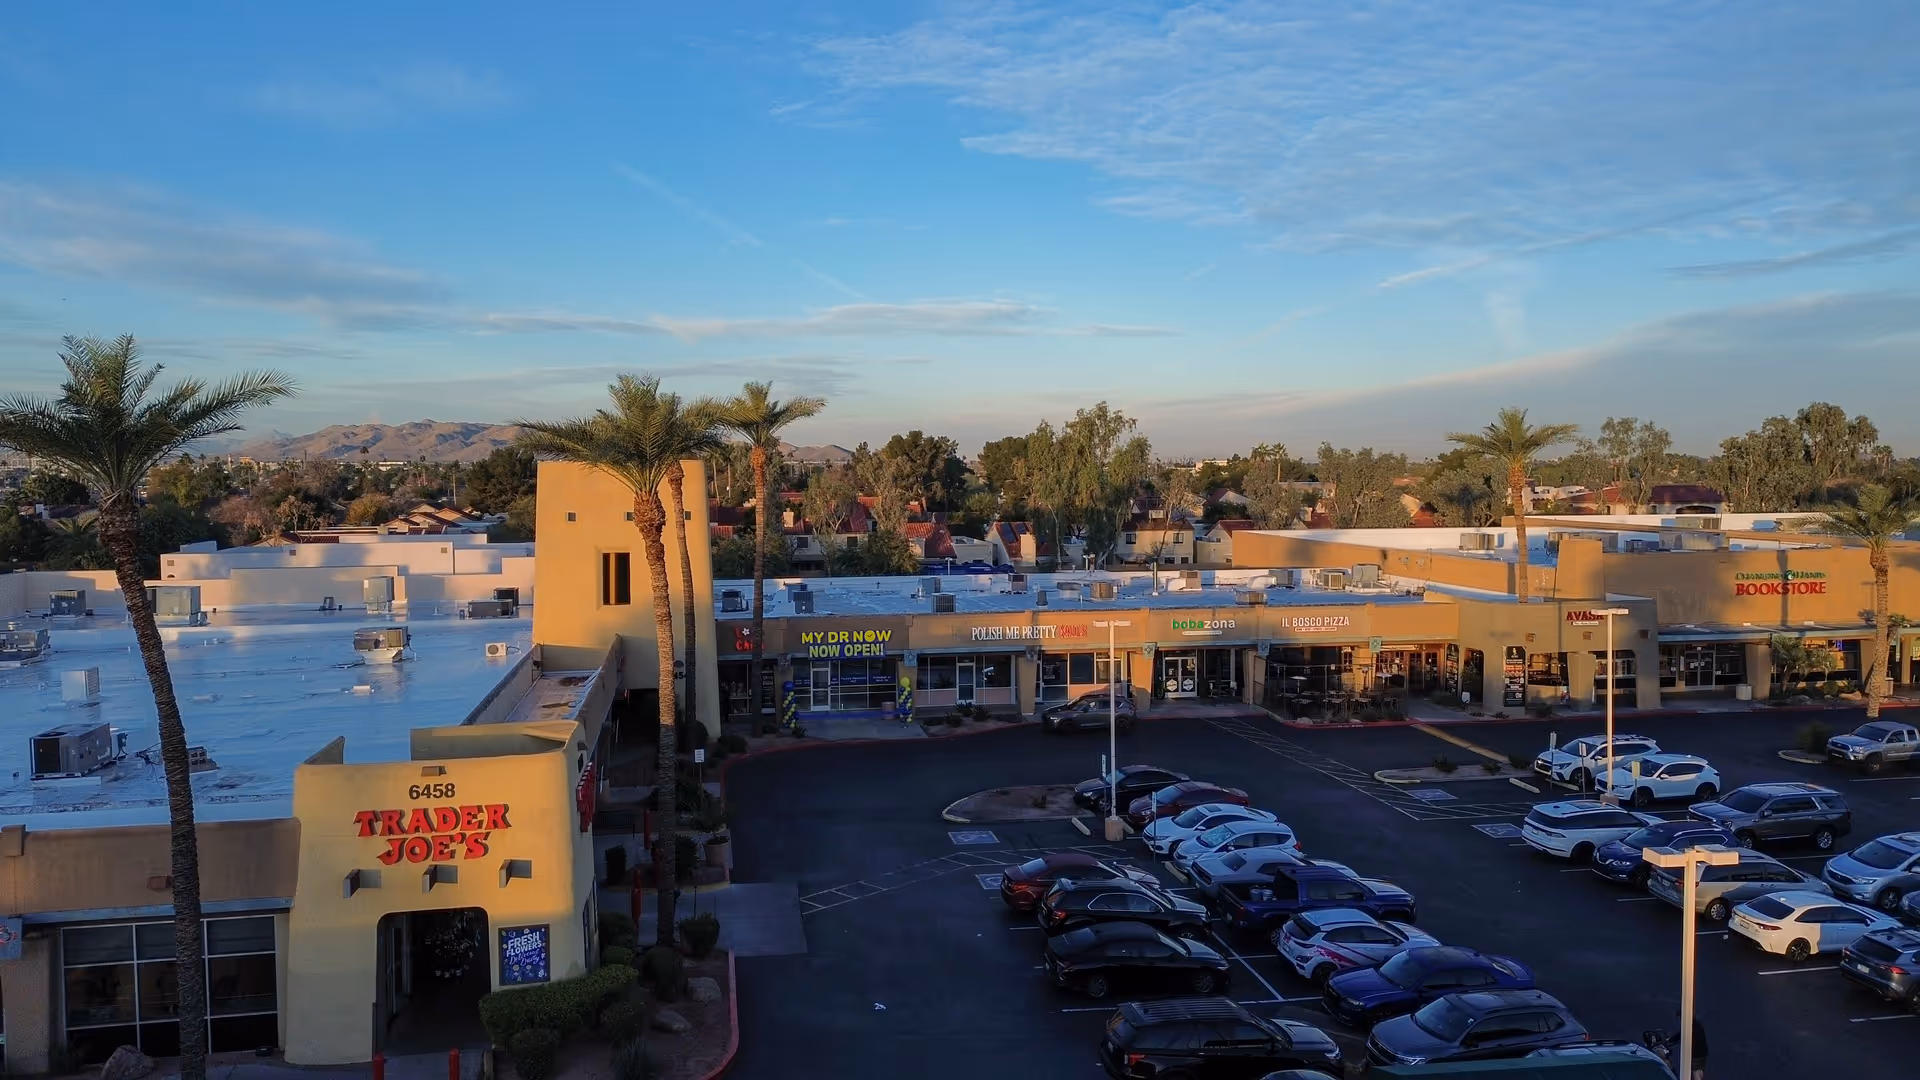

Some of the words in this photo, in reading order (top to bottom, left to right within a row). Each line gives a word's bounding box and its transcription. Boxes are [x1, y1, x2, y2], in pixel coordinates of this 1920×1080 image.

[1736, 582, 1826, 595] BOOKSTORE
[1172, 618, 1236, 629] bobazona
[1282, 618, 1290, 627] IL
[1292, 617, 1322, 627] BOSCO
[1325, 616, 1350, 626] PIZZA
[801, 631, 825, 645] MY
[828, 630, 850, 643] DR
[853, 629, 892, 642] NOW
[972, 627, 1003, 640] POLISH
[1006, 626, 1020, 639] ME
[1022, 625, 1057, 639] PRETTY
[809, 645, 841, 658] NOW
[845, 643, 884, 657] OPEN!
[408, 783, 456, 800] 6458
[353, 803, 512, 837] TRADER
[376, 831, 491, 865] JOE'S
[506, 940, 542, 957] FLOWERS
[508, 931, 540, 950] FRESH
